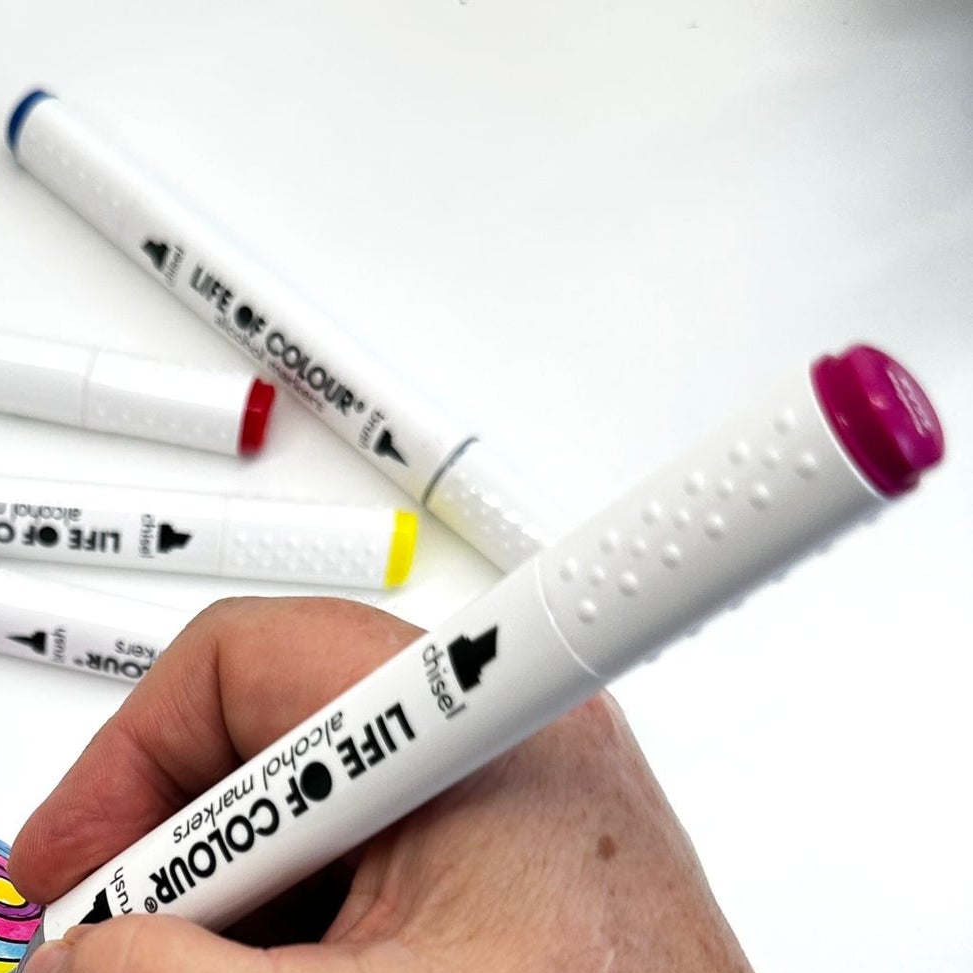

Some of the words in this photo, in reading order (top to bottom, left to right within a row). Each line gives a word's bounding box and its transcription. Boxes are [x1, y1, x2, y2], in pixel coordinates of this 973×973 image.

[189, 263, 235, 313] LIFE
[234, 305, 267, 338] OF
[10, 501, 82, 523] alcohol
[21, 524, 60, 547] OF
[68, 528, 121, 554] LIFE
[139, 513, 155, 559] chisel
[421, 642, 467, 720] chisel
[264, 710, 344, 791] alcohol
[336, 702, 416, 780] LIFE
[173, 782, 255, 844] markers
[285, 760, 333, 818] OF
[110, 866, 133, 915] rush
